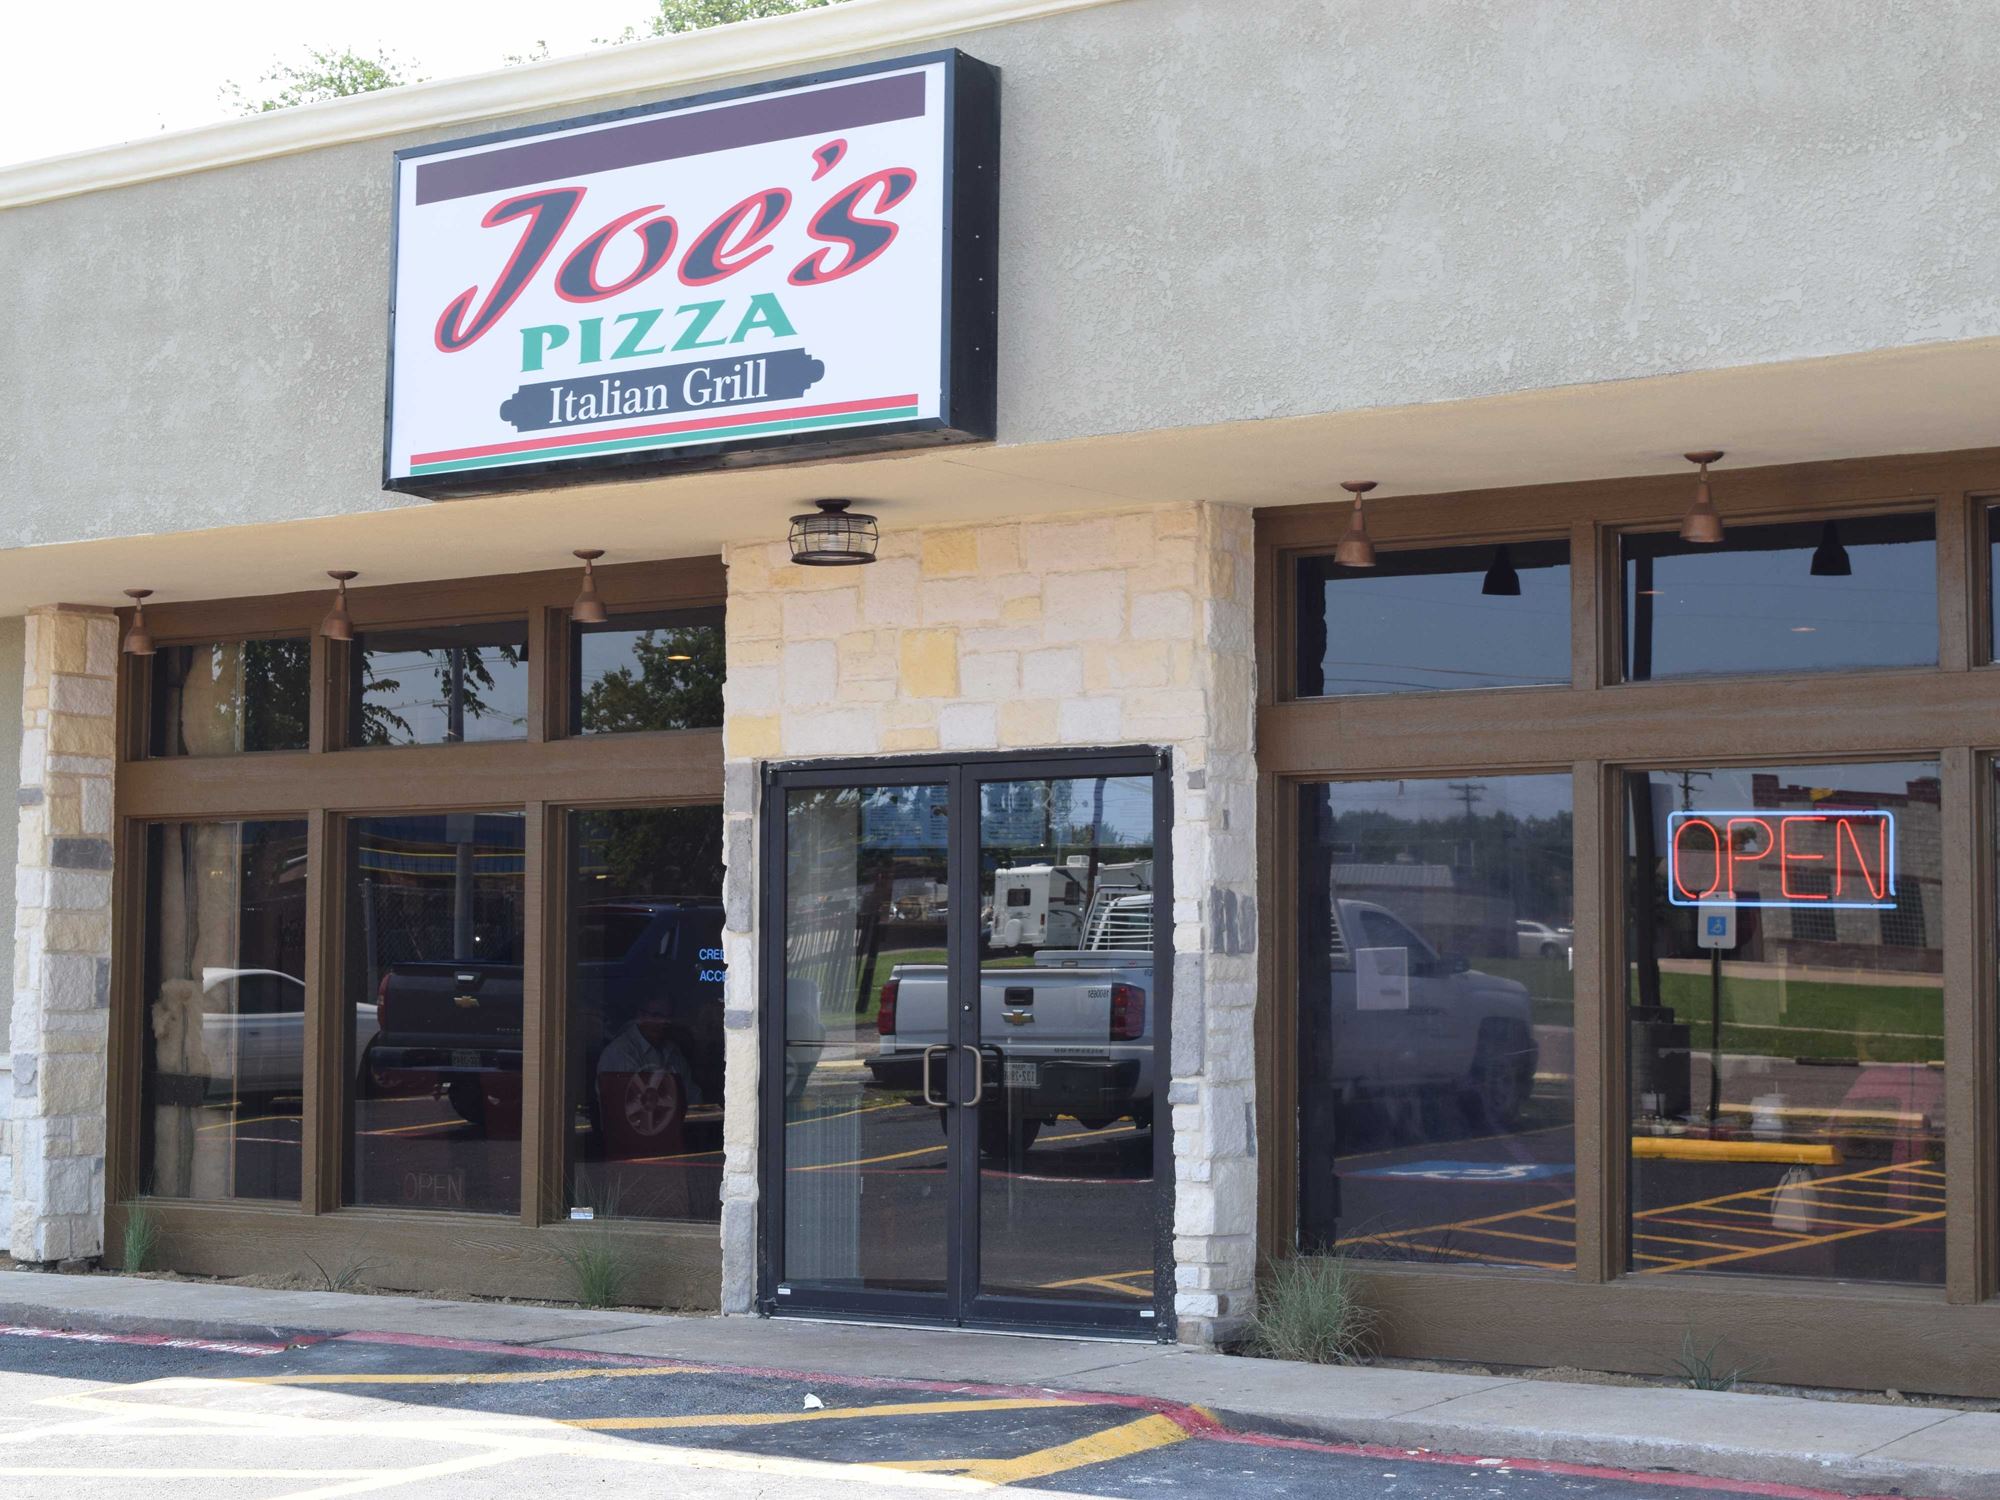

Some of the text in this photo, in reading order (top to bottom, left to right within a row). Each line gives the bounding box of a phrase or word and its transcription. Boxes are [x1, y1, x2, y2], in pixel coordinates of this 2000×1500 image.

[434, 138, 918, 354] Joe's
[519, 292, 798, 373] PIZZA
[549, 360, 769, 425] Italian Grill
[1674, 817, 1886, 899] OPEN
[403, 1172, 464, 1202] OPEN
